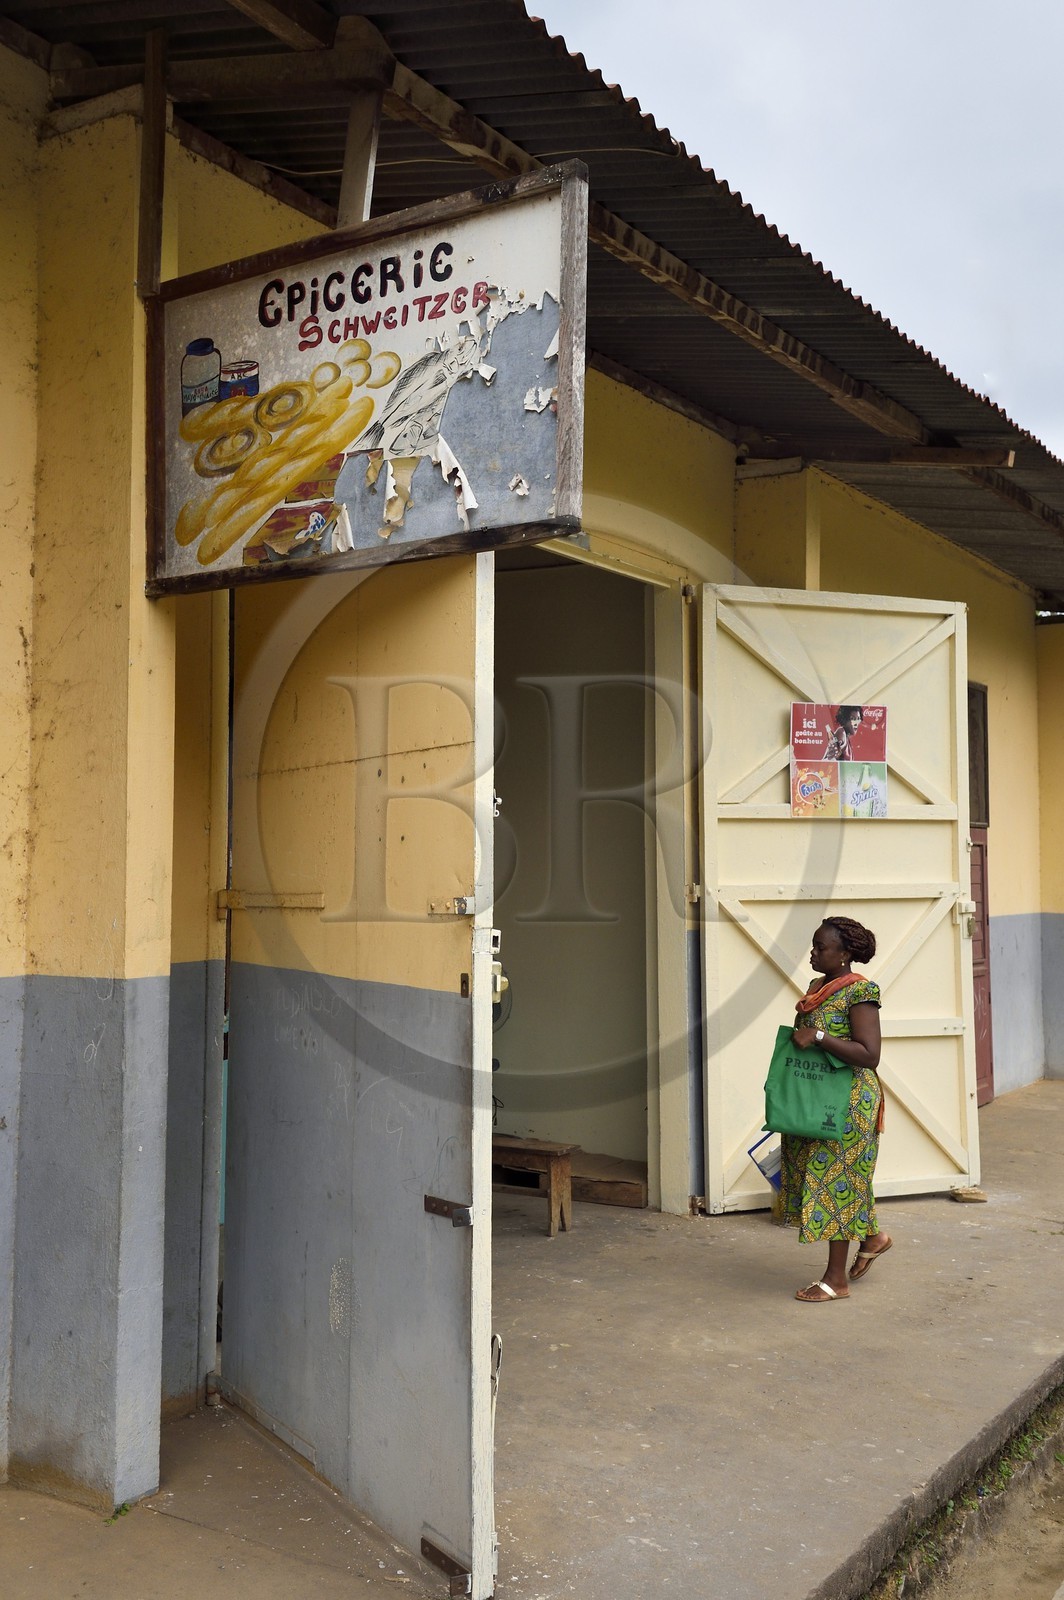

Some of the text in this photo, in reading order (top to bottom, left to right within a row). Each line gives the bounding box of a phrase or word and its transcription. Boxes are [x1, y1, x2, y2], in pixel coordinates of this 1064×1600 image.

[298, 281, 491, 351] SCHWEITZER
[802, 718, 817, 729] ici
[795, 729, 814, 738] goûte
[794, 737, 823, 745] bonheur
[800, 781, 822, 797] Fanta
[793, 1070, 825, 1081] GABON
